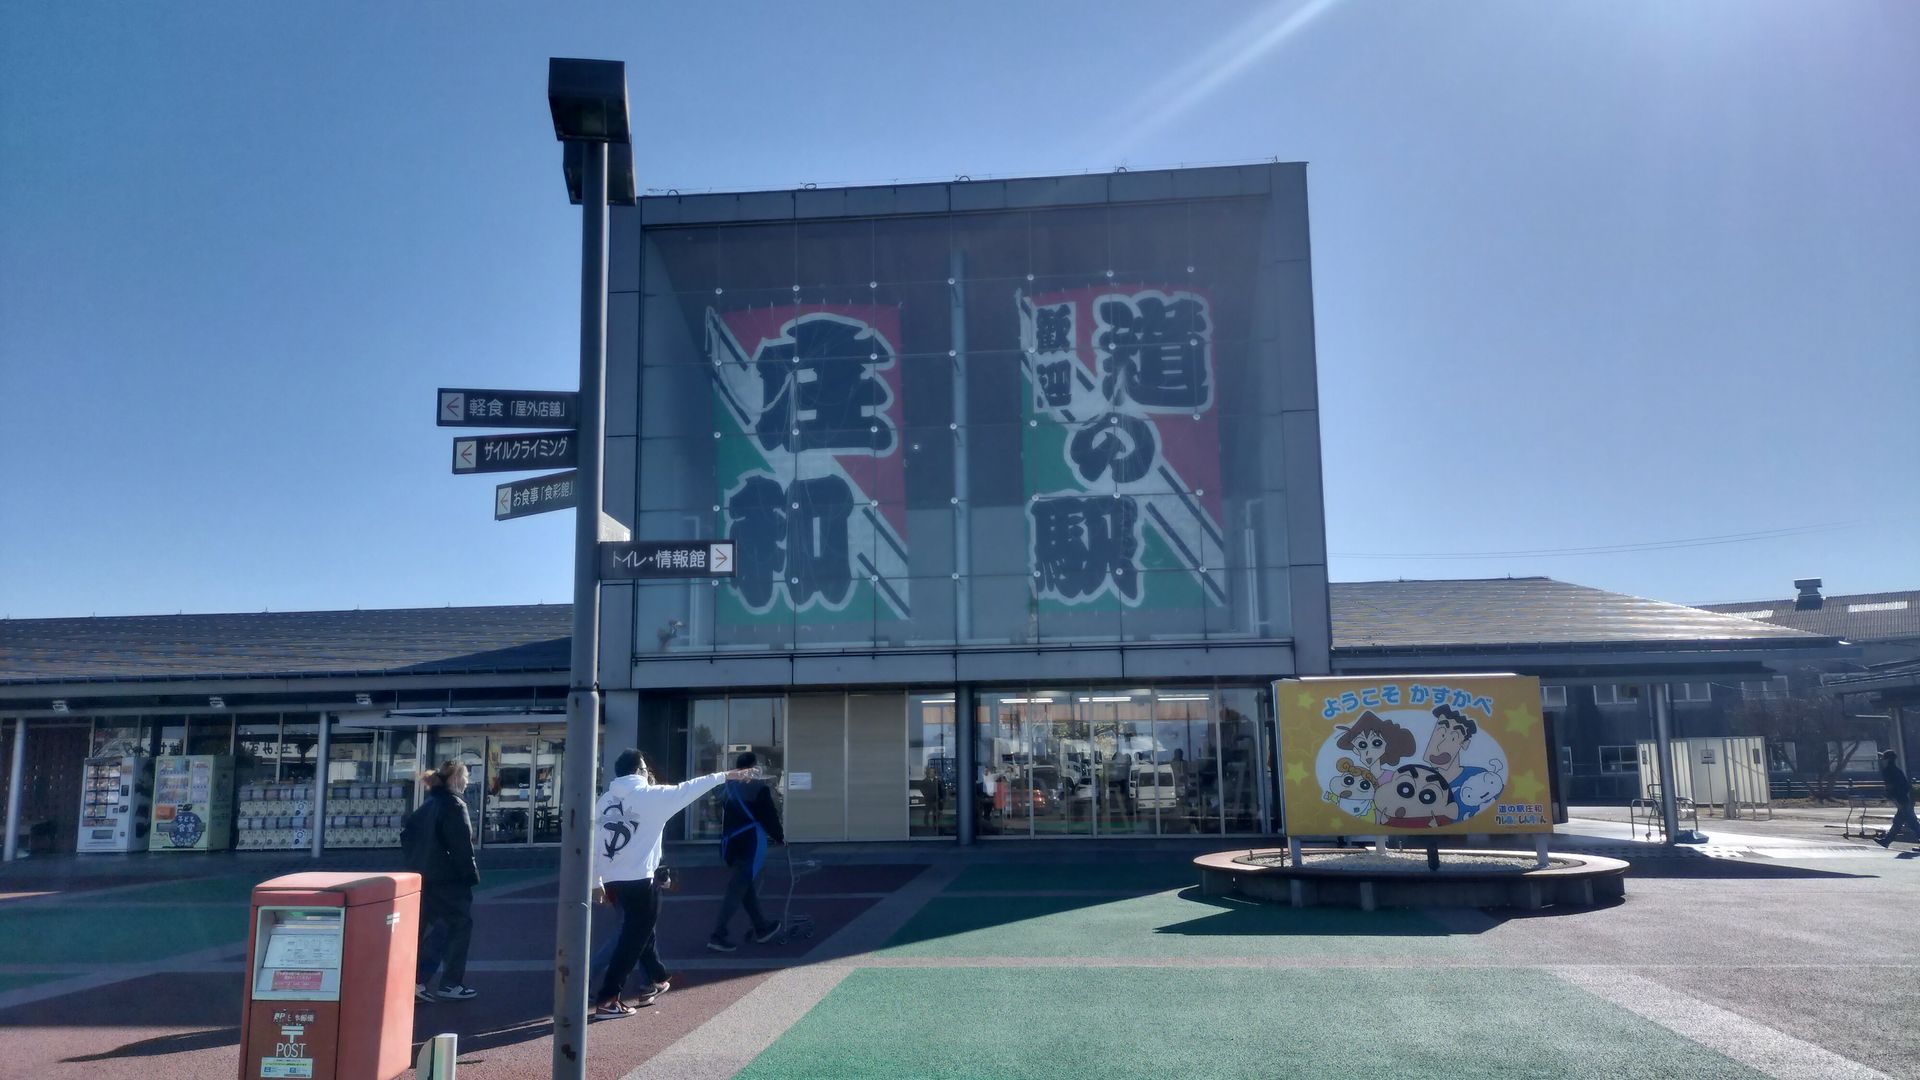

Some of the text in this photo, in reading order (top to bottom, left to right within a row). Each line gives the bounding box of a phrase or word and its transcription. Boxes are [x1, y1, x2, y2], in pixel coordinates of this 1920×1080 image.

[484, 437, 568, 462] ザイルクライミング
[612, 550, 706, 569] トイレ・情報館
[1323, 684, 1493, 718] ようこそ かすかべ
[1499, 804, 1543, 814] 道の駅庄和
[275, 1042, 307, 1058] POST
